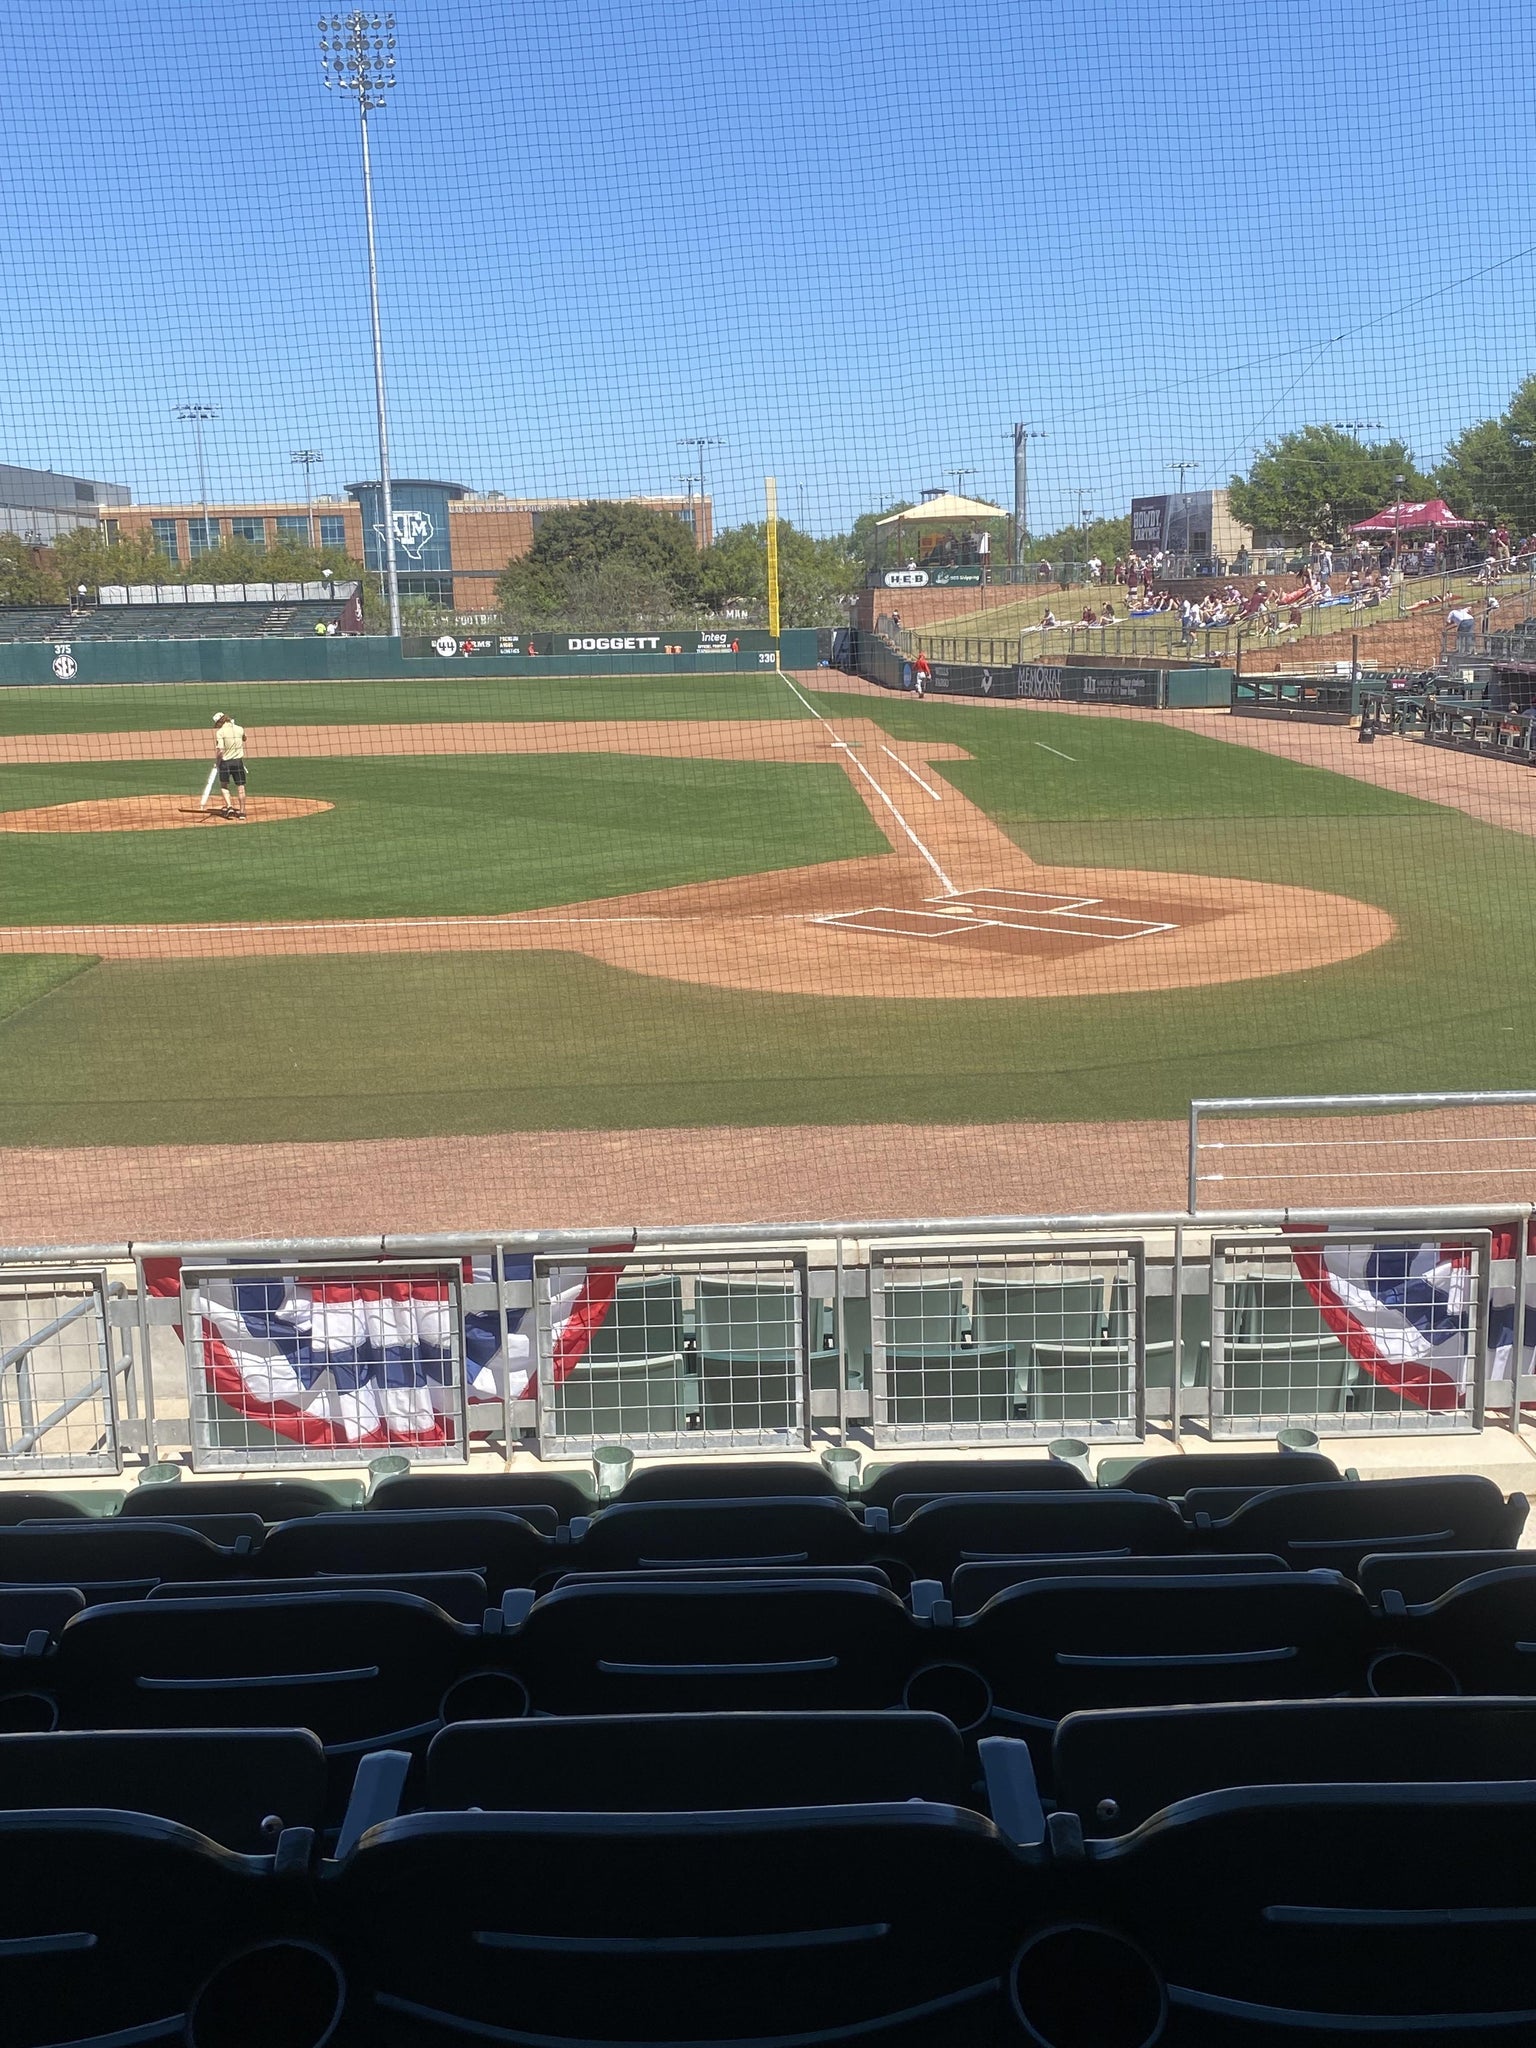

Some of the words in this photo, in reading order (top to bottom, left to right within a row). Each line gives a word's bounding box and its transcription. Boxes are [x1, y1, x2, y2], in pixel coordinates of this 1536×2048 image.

[568, 636, 660, 650] DOGGETT
[701, 632, 727, 643] Integ
[54, 644, 72, 655] 375
[459, 640, 492, 648] FRMS
[758, 653, 776, 663] 330
[54, 656, 76, 678] SEC
[1018, 667, 1063, 684] MEMORIAL
[1017, 681, 1062, 698] HERMANN
